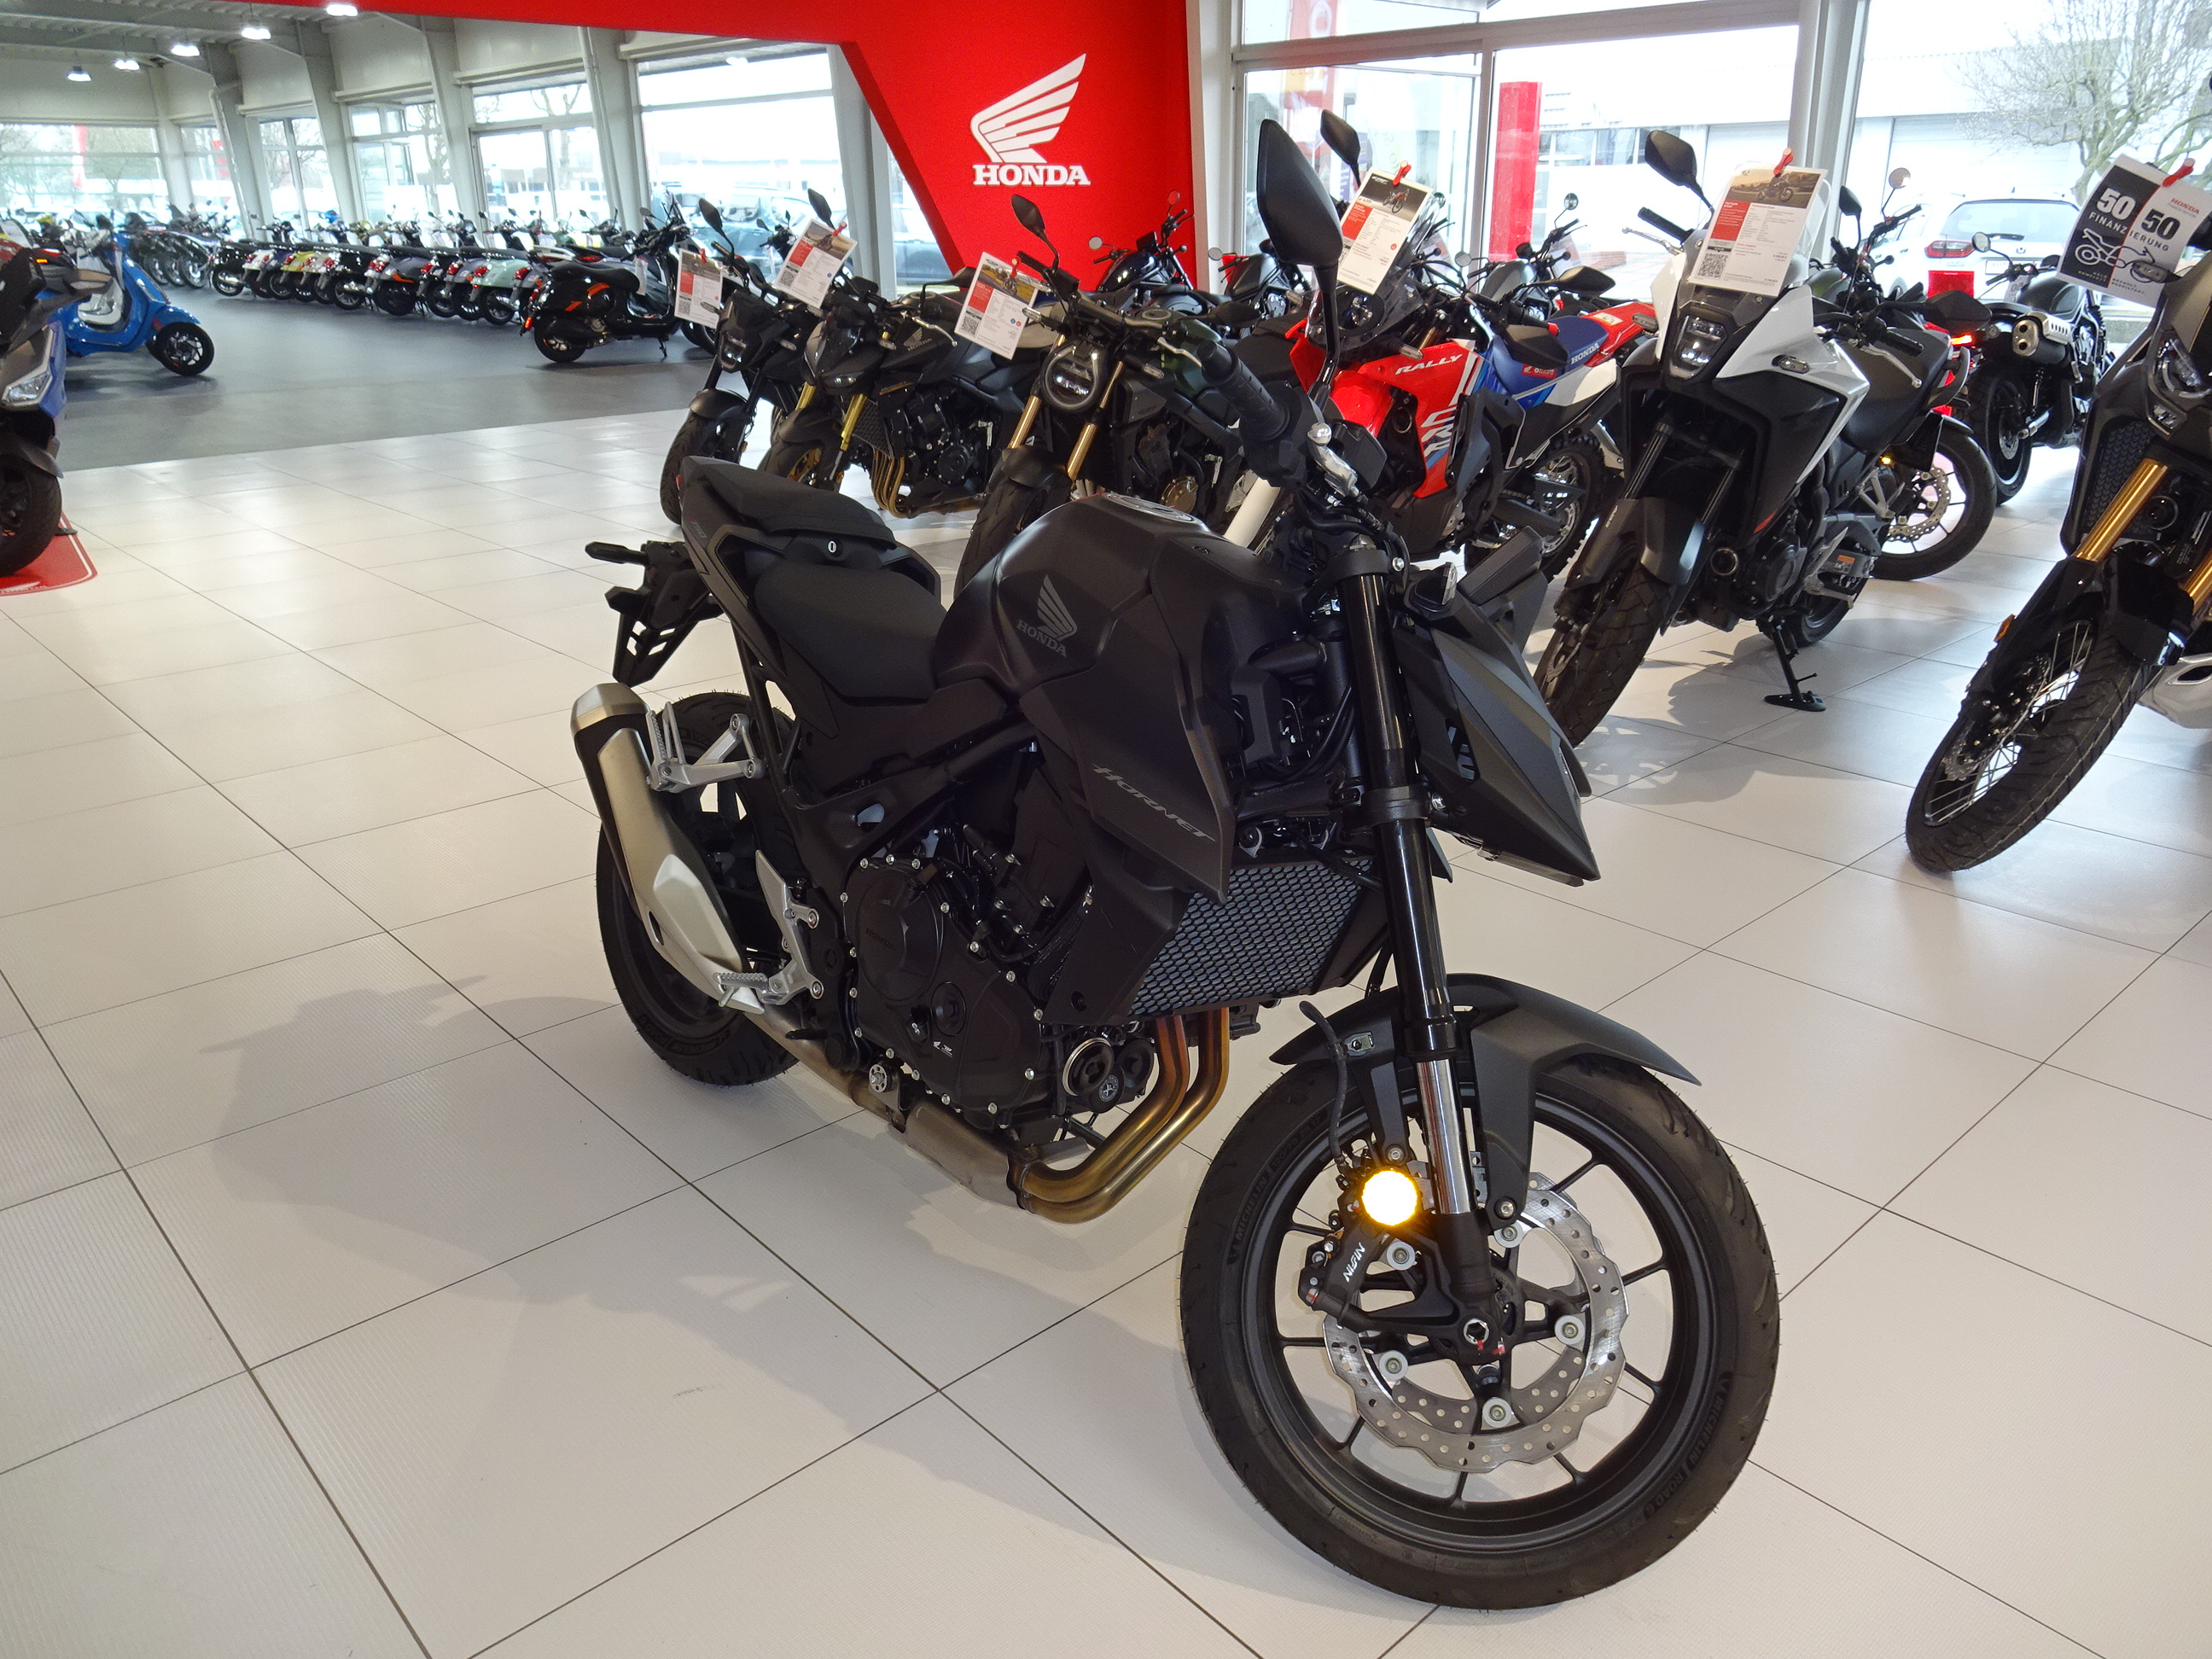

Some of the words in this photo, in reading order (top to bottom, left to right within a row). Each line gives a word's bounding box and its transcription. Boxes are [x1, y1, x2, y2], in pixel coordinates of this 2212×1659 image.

[972, 164, 1091, 186] HONDA
[2096, 187, 2136, 220] 50
[2170, 197, 2200, 214] HONDA
[2141, 208, 2180, 241] 50
[1394, 353, 1463, 375] RALLY
[1570, 342, 1600, 364] HONDA
[1016, 619, 1067, 657] HONDA
[1234, 1172, 1270, 1242] MICHELIN
[1687, 1395, 1727, 1468] MICHELIN
